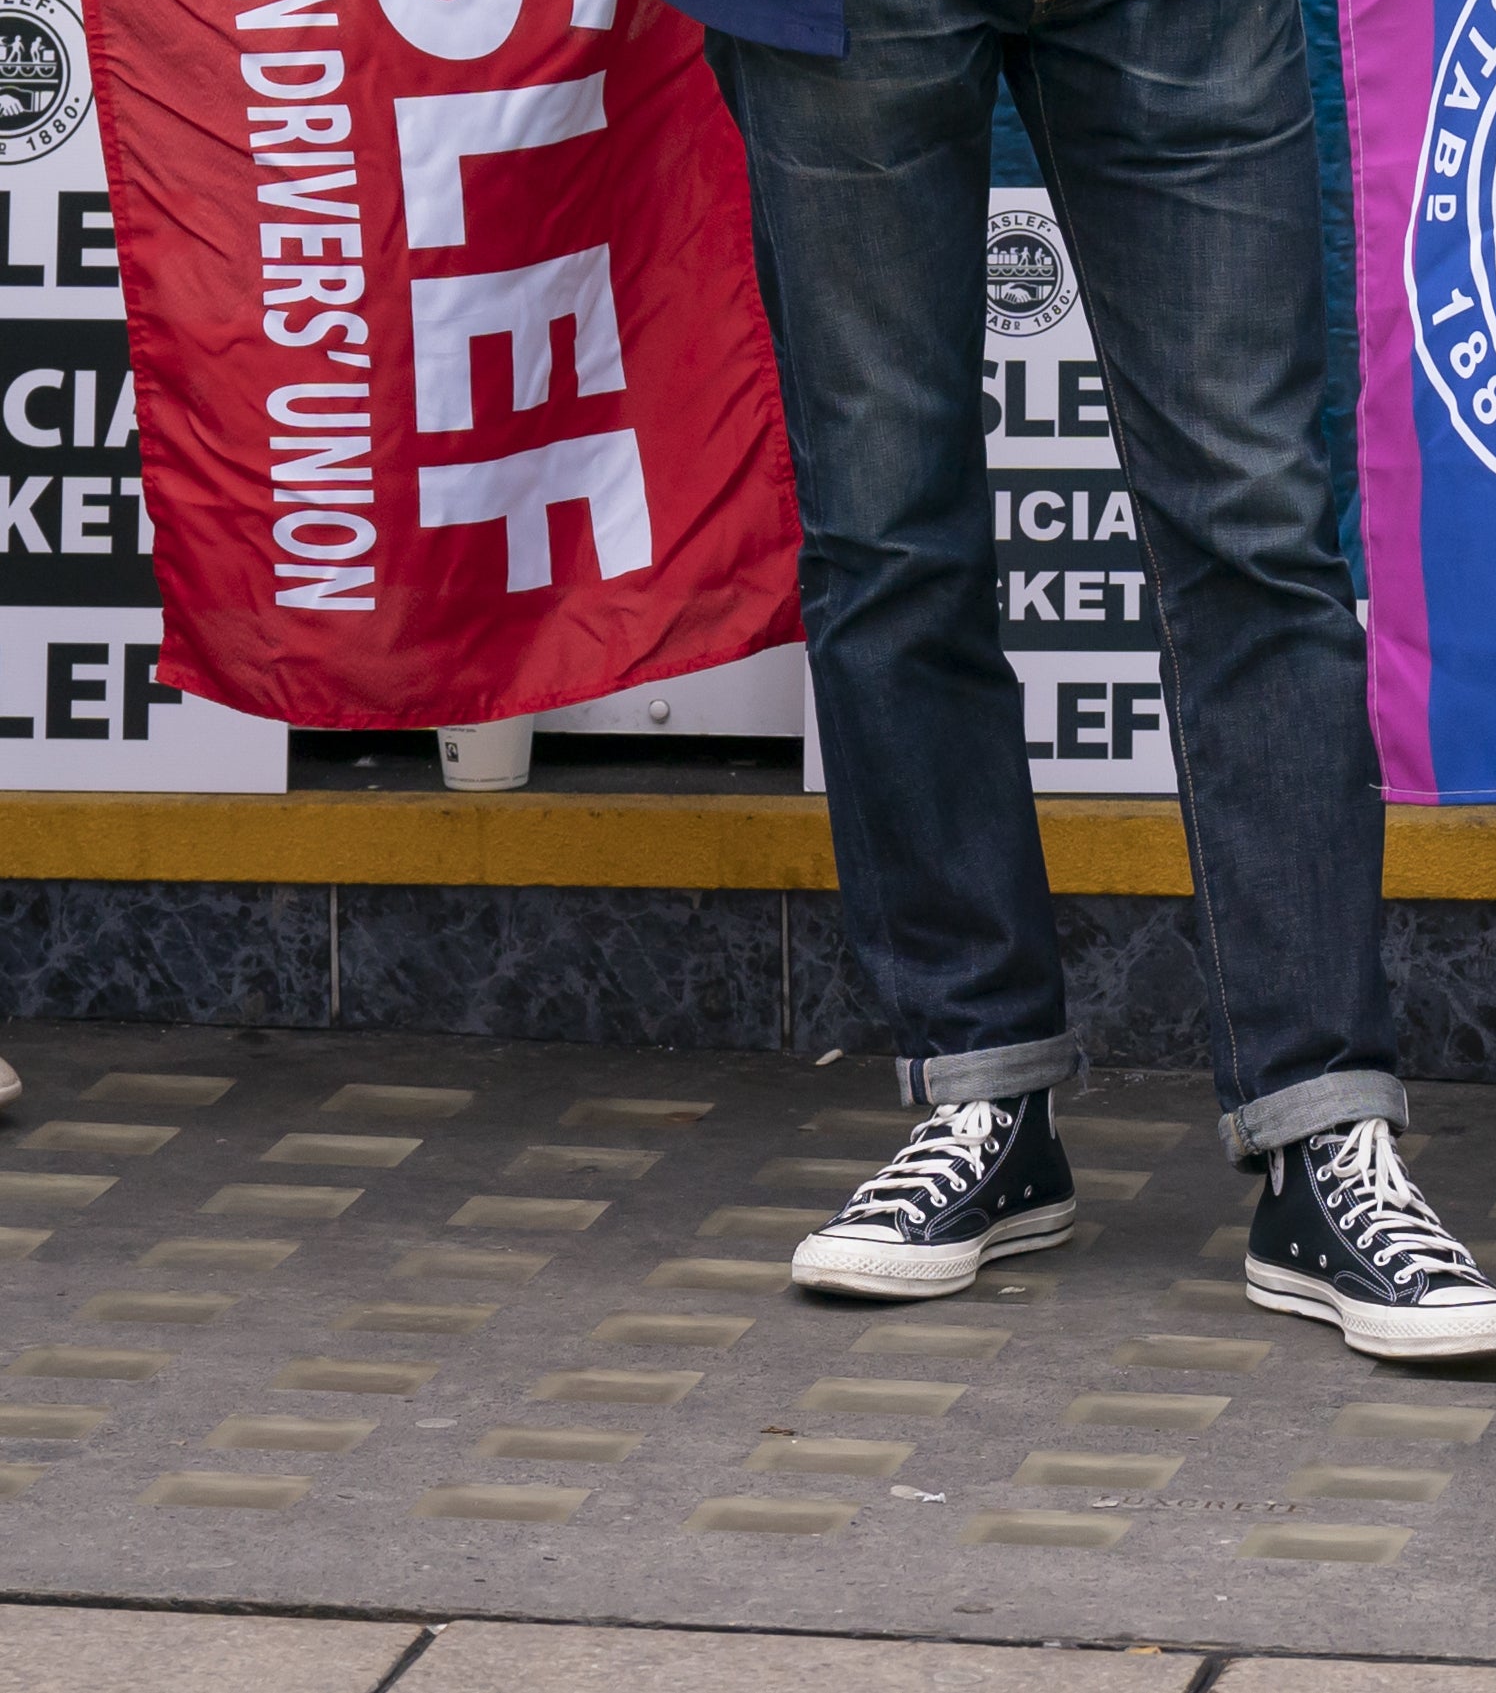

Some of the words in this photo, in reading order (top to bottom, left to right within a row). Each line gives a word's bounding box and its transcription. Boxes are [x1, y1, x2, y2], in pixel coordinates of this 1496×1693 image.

[26, 105, 77, 152] 1880
[240, 51, 369, 374] DRIVERS'
[990, 215, 1048, 233] ASLEF
[1033, 295, 1070, 328] 1880
[266, 383, 378, 611] UNION
[996, 571, 1146, 621] KET
